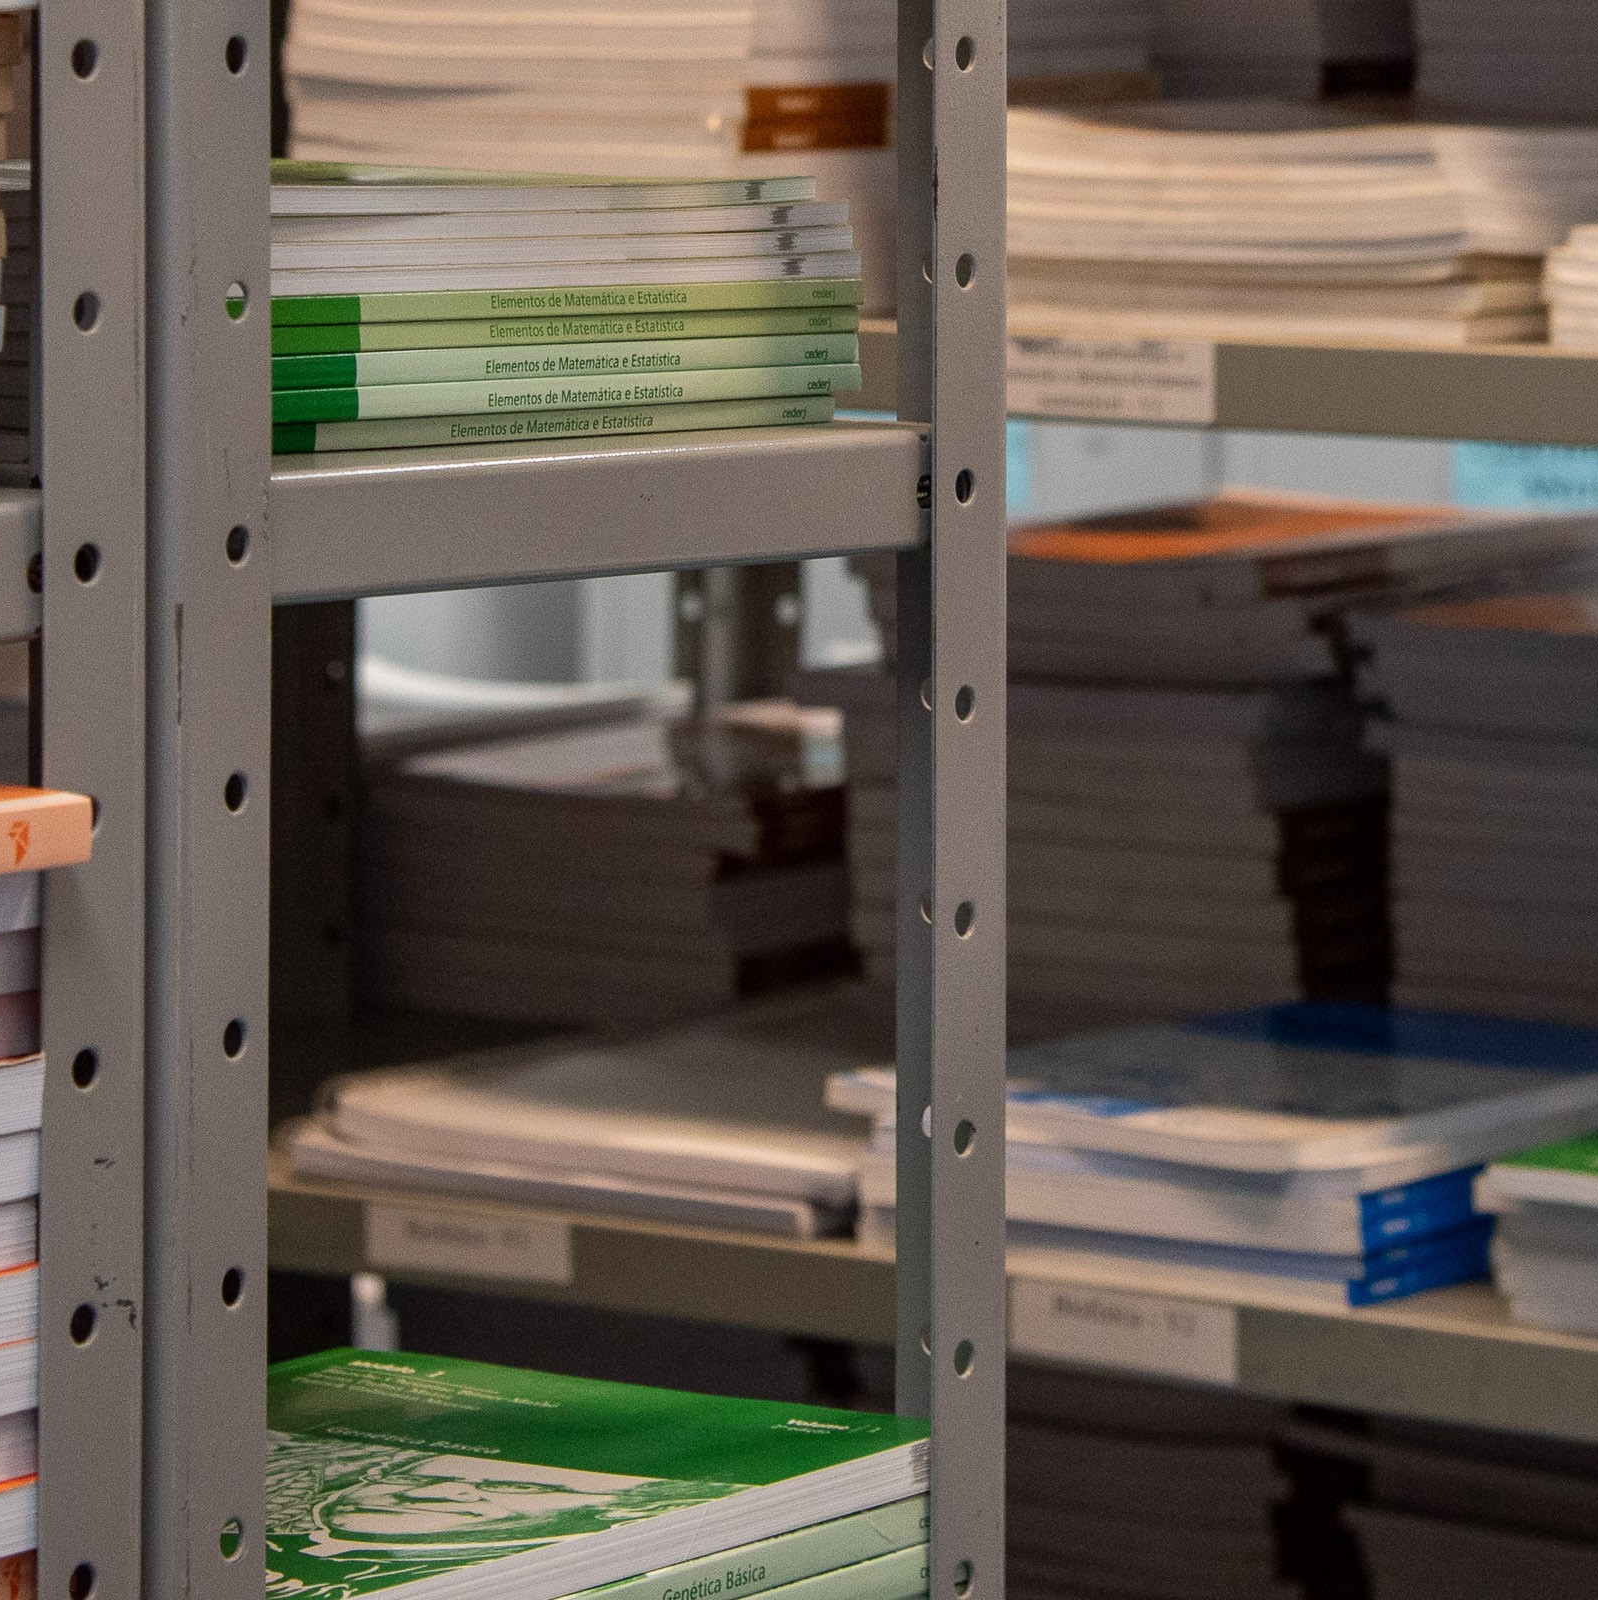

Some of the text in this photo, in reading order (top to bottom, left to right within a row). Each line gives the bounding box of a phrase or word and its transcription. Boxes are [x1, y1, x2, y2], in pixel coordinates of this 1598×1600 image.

[491, 289, 687, 310] Elementos de Matemática e Estatística
[812, 288, 836, 301] cederj
[489, 318, 685, 339] Elementos de Matemática e Estatística
[808, 315, 832, 328] cederj
[485, 352, 681, 374] Elementos de Matemática e Estatística
[804, 348, 828, 362] cederj
[807, 378, 831, 391] cederj
[488, 384, 684, 407] Elementos de Matemática e Estatística
[782, 406, 806, 420] cederj
[450, 414, 653, 438] Elementos de Matemática e Estatística
[663, 1564, 767, 1600] Genética Básica
